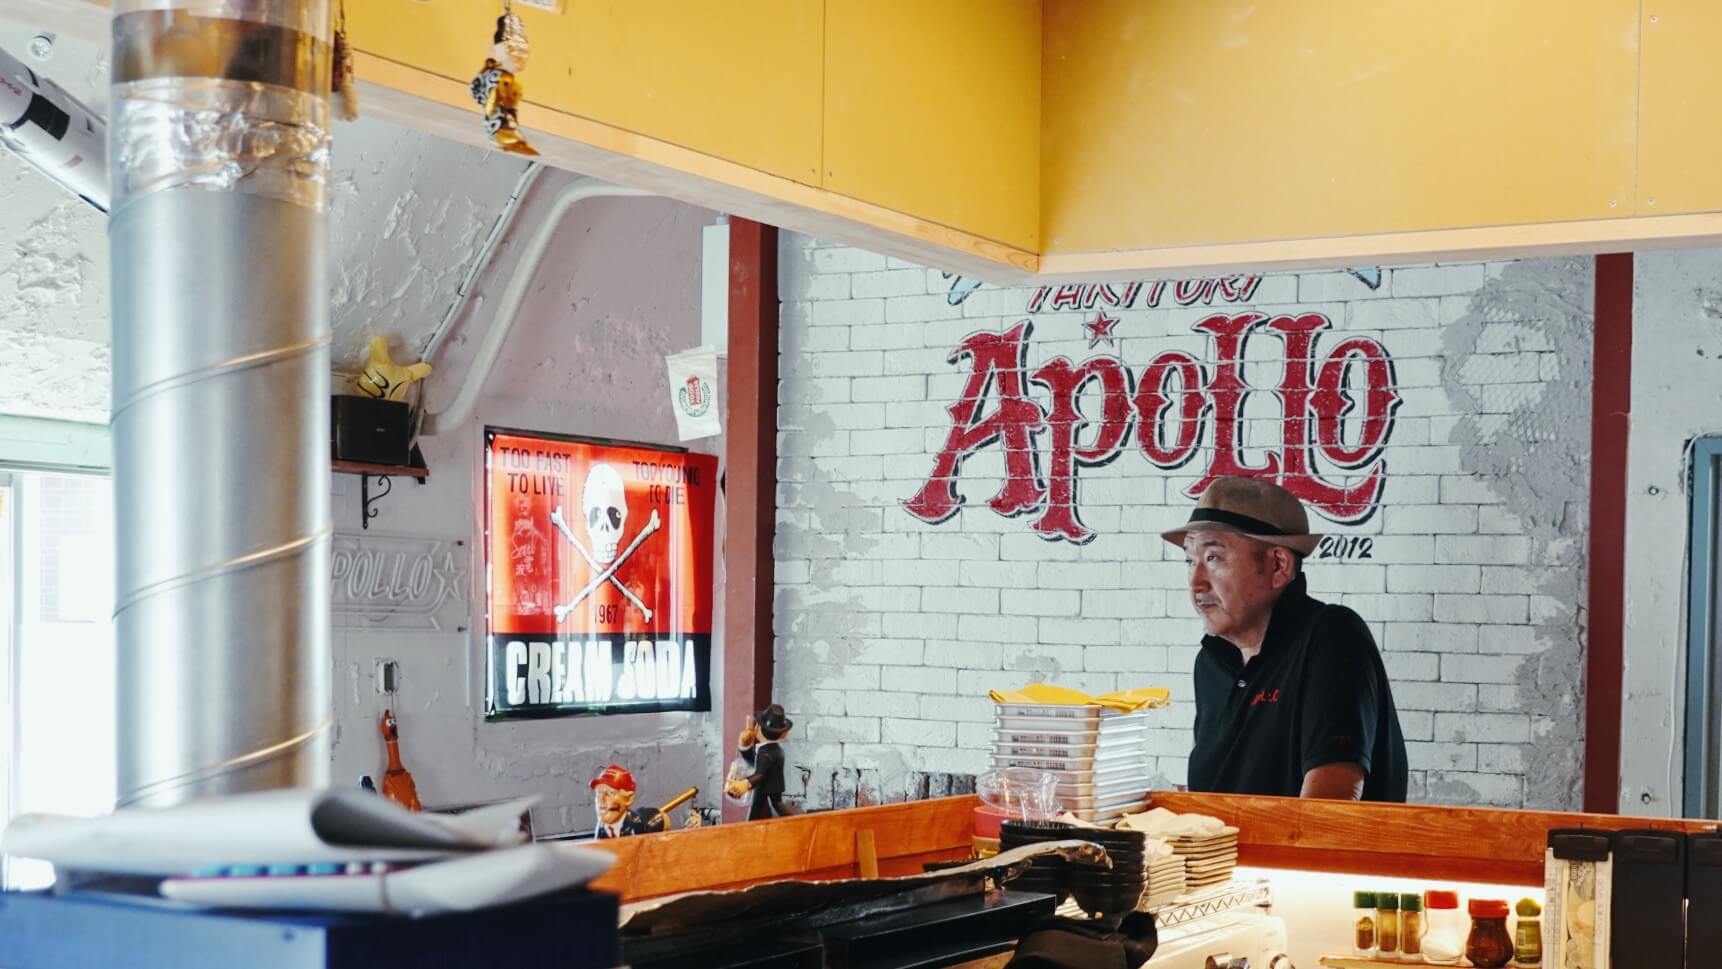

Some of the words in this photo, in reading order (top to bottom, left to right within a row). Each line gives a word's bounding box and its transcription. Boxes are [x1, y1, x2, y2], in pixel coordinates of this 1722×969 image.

[500, 446, 531, 471] TOO
[535, 450, 571, 474] FAST
[507, 472, 529, 494] TO
[533, 475, 565, 497] LIVE
[649, 484, 662, 502] TO
[664, 485, 686, 505] DIE
[1319, 536, 1374, 559] 2012
[594, 604, 619, 625] 1967
[506, 640, 613, 705] CREAM
[616, 640, 697, 700] SODA
